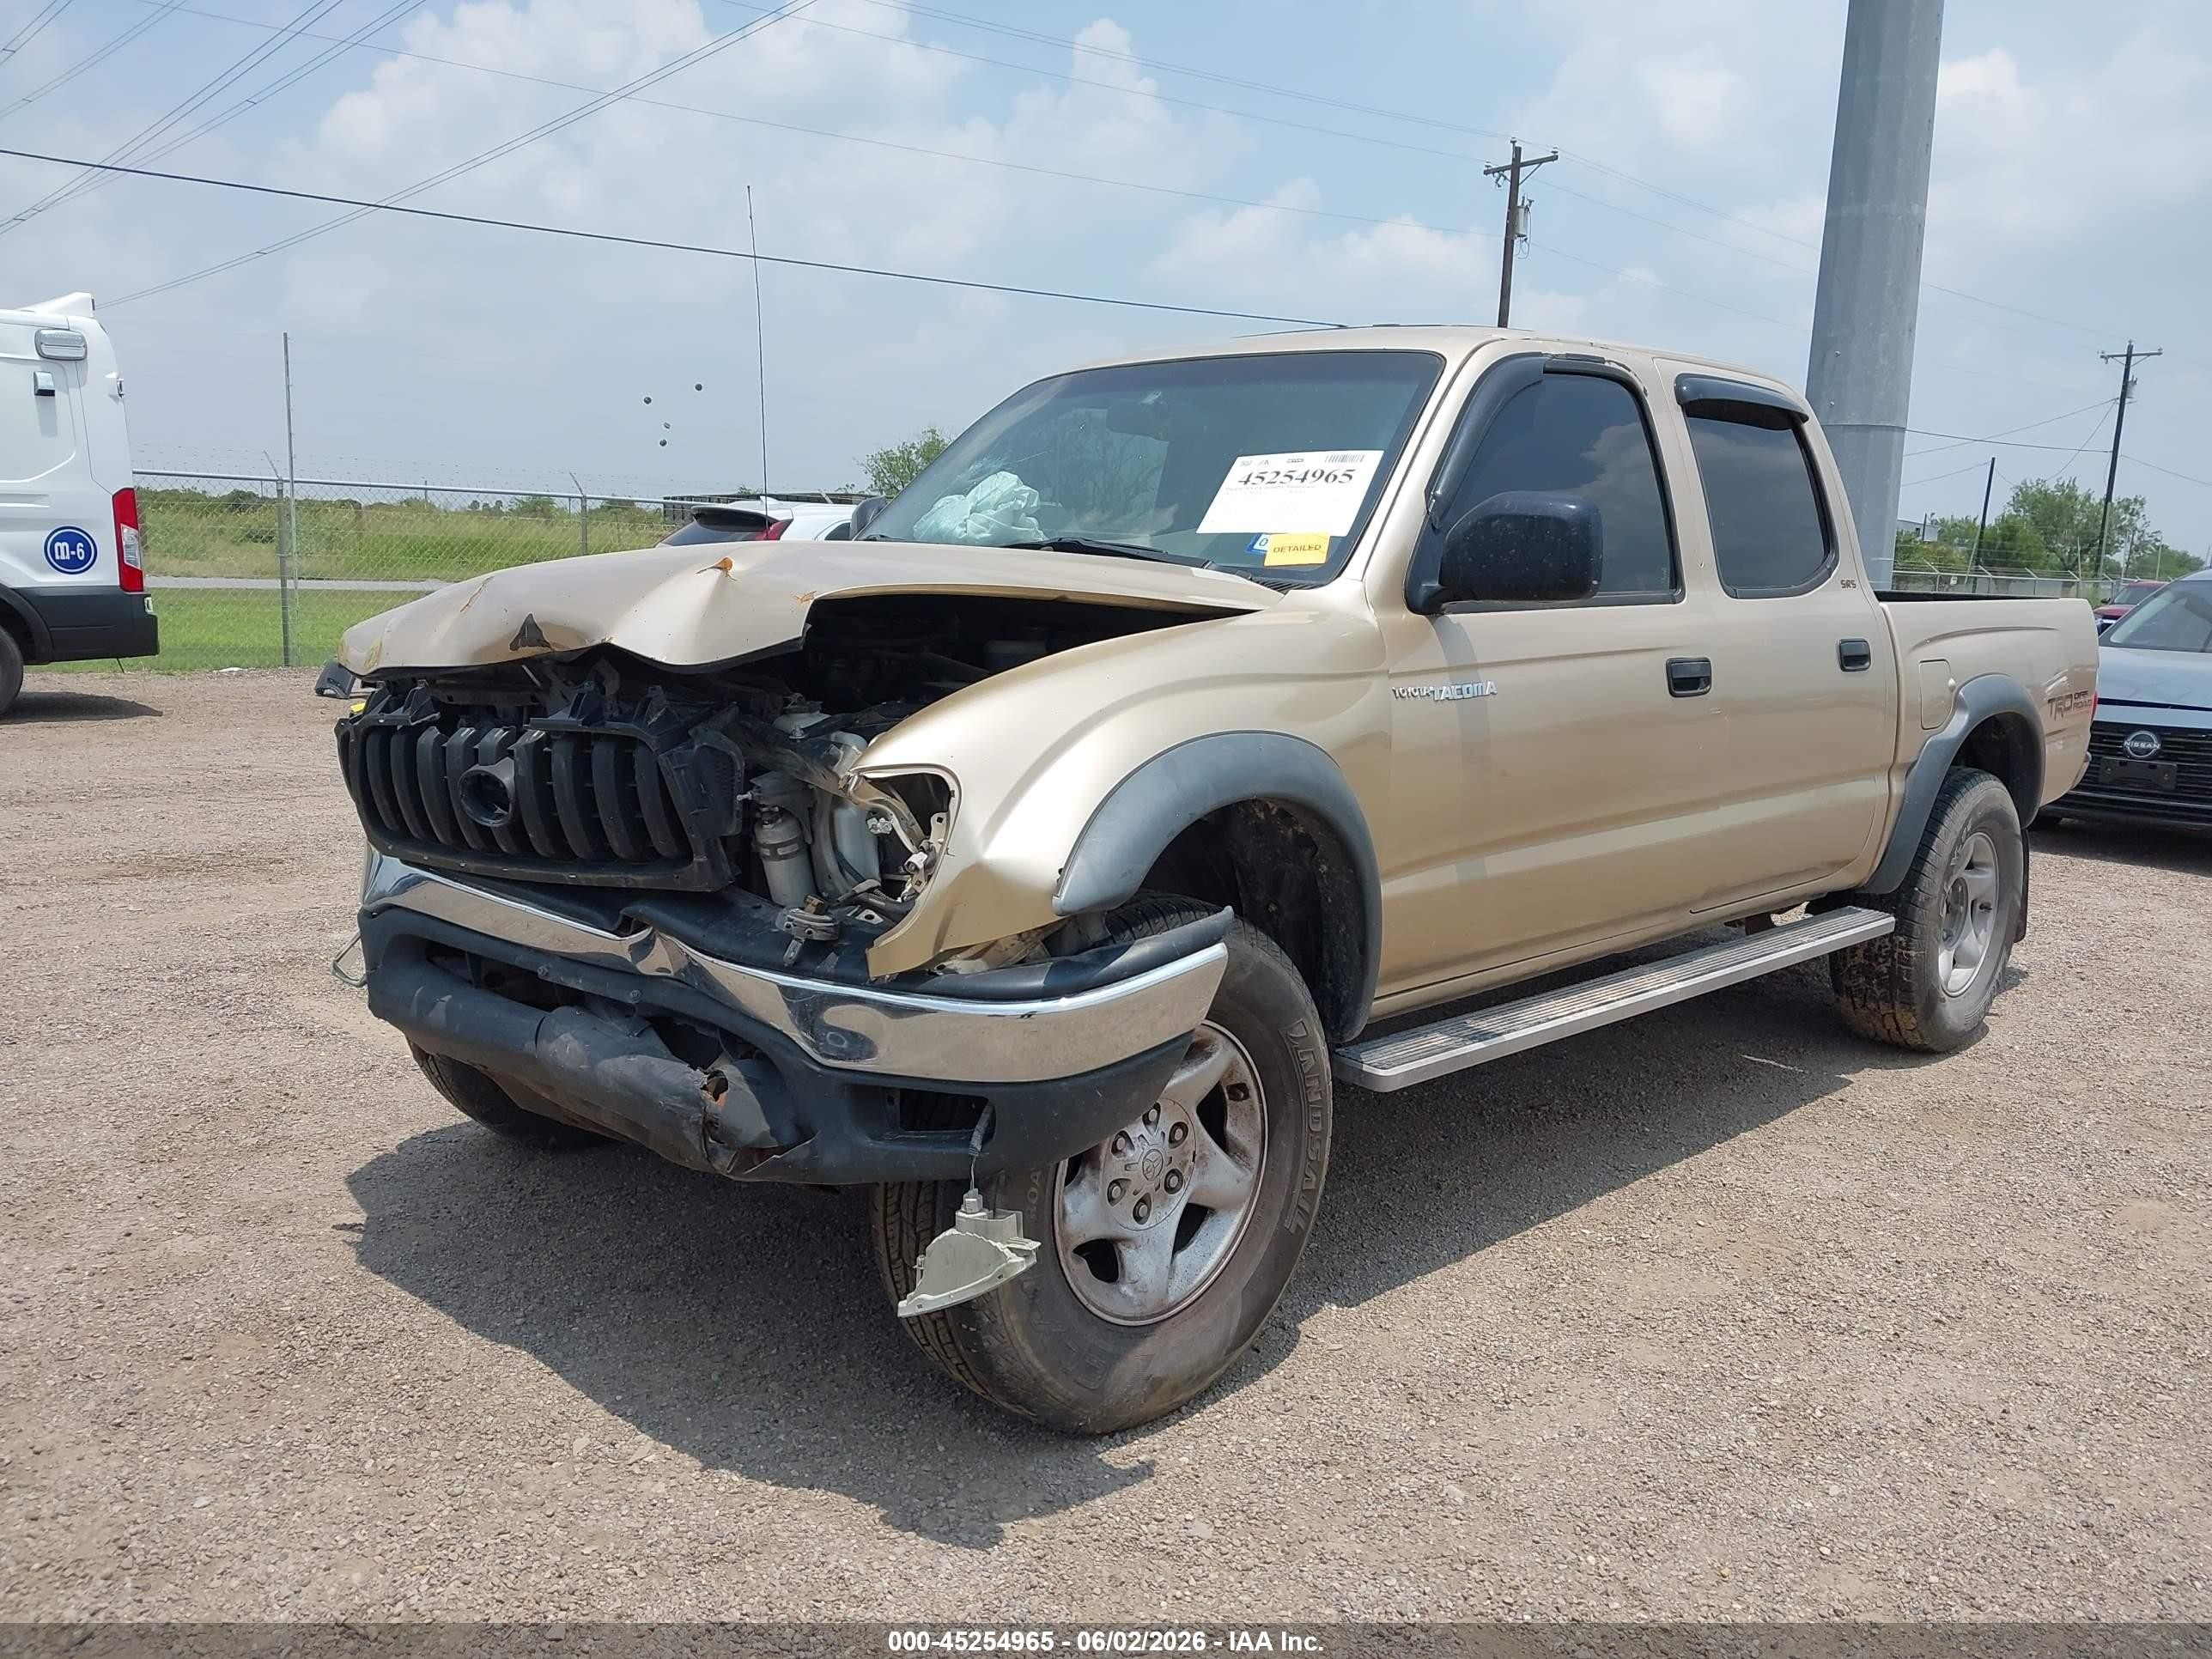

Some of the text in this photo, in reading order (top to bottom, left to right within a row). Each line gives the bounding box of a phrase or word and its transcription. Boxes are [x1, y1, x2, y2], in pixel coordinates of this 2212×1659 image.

[1238, 468, 1355, 486] 45254965
[1273, 543, 1322, 554] DETAILED
[1392, 680, 1498, 702] TOYOTA TACOMA
[2047, 691, 2088, 720] TRD OFF
[2073, 699, 2092, 710] ROAD
[1288, 1018, 1322, 1234] LANDSAIL
